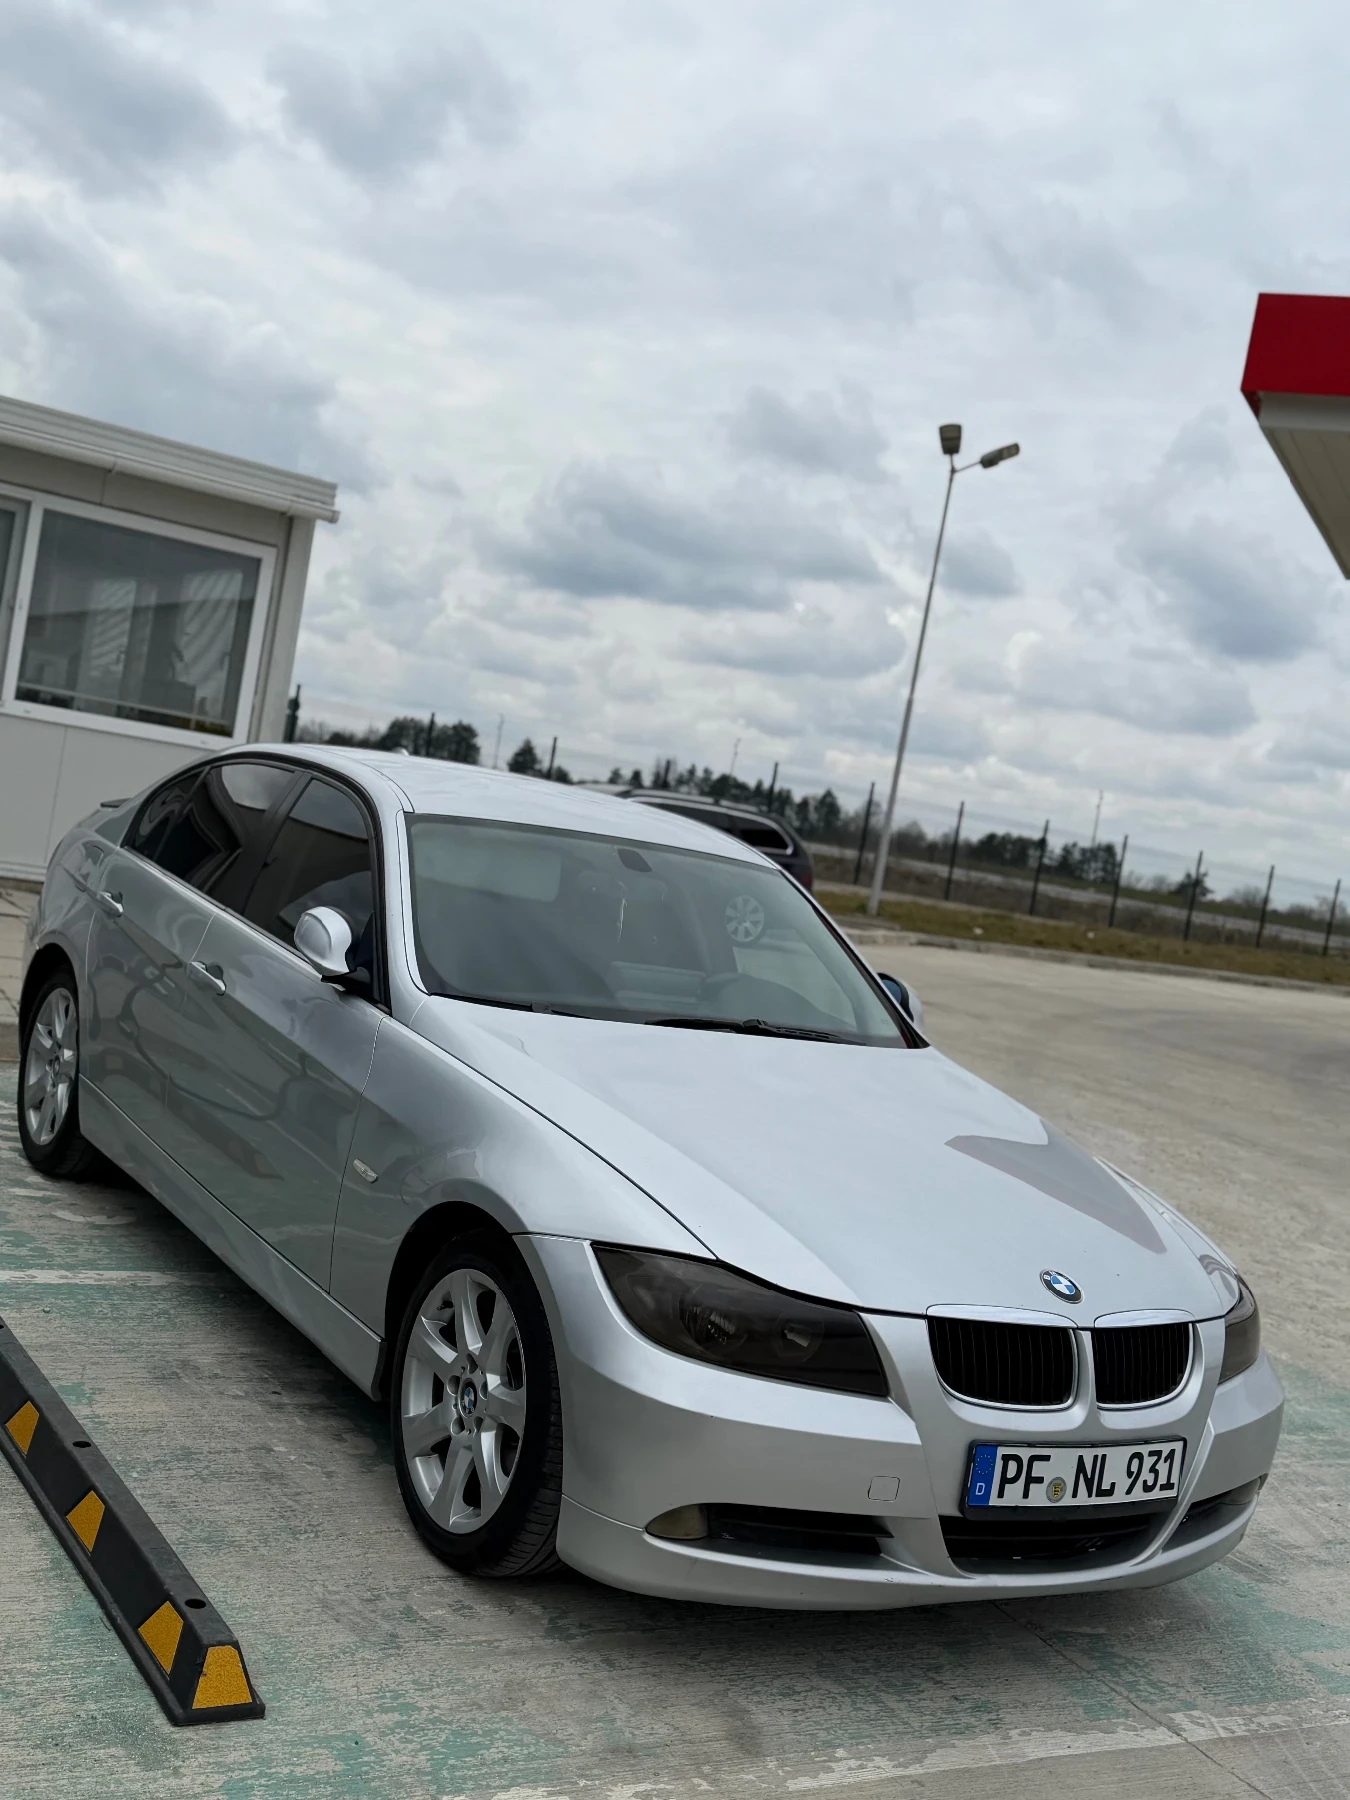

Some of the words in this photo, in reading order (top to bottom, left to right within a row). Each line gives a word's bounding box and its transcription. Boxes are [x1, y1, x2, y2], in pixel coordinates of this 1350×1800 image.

[975, 1482, 986, 1496] D
[997, 1453, 1051, 1499] PF
[1072, 1454, 1116, 1498] NL
[1125, 1448, 1176, 1496] 931
